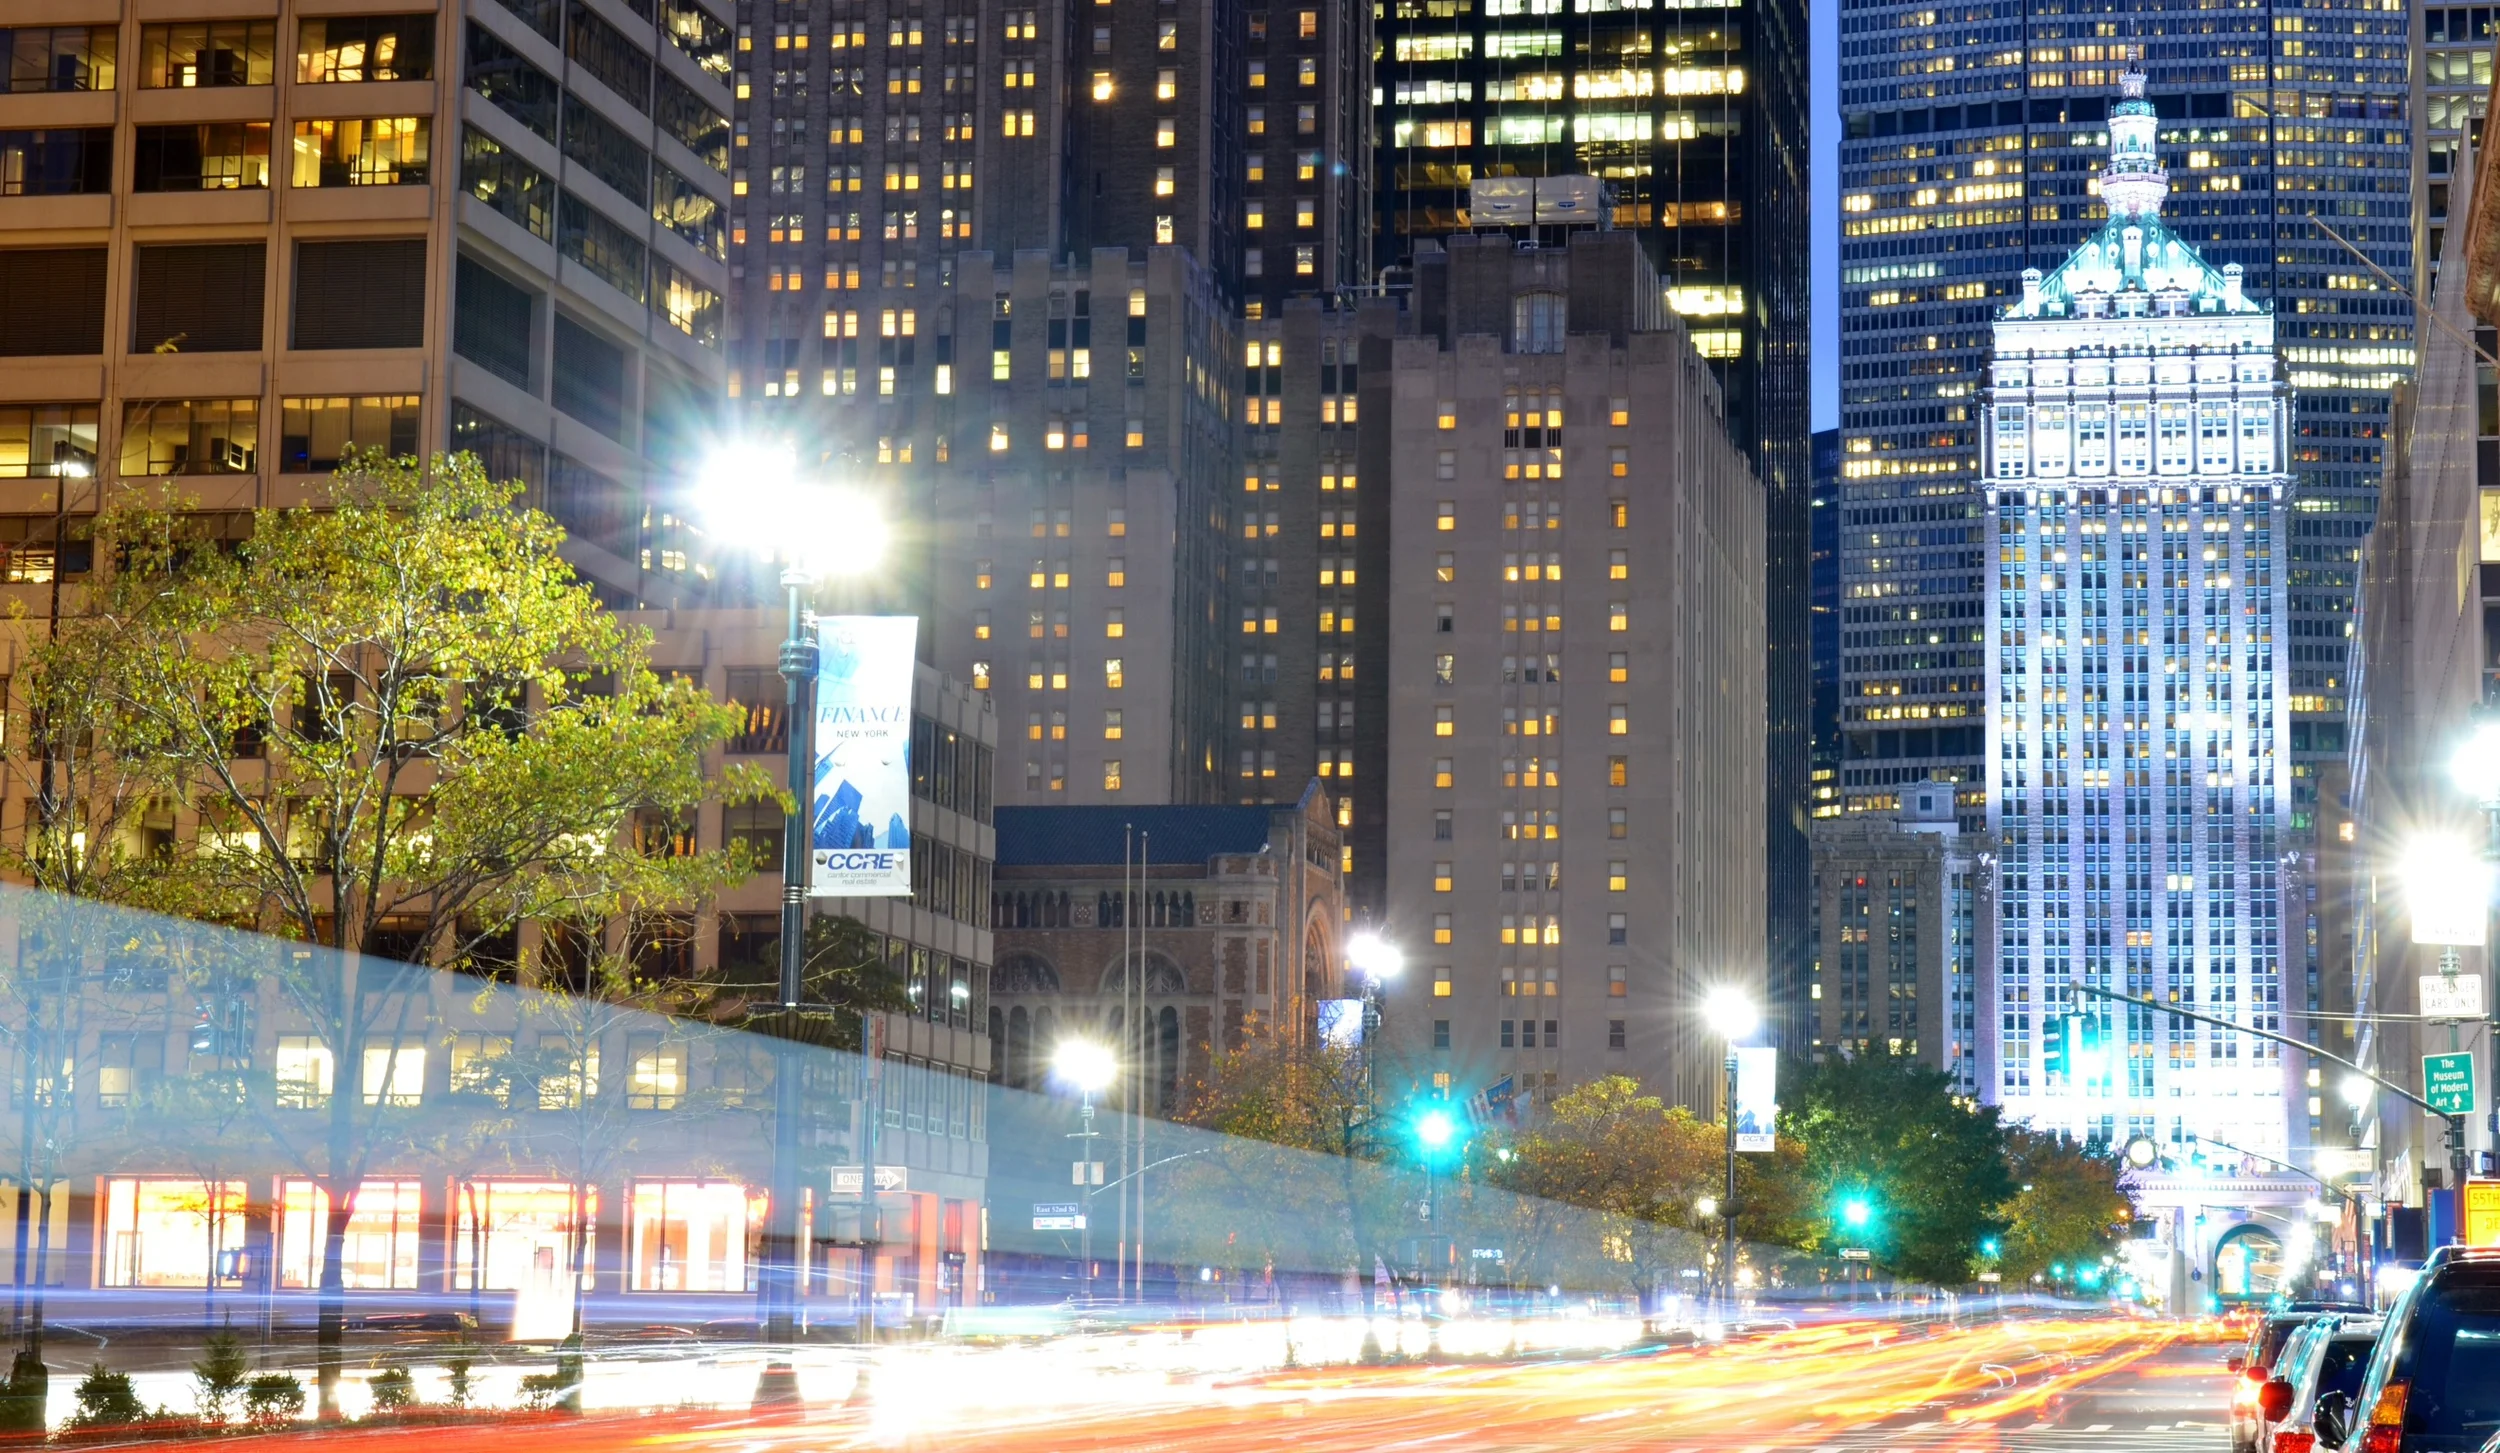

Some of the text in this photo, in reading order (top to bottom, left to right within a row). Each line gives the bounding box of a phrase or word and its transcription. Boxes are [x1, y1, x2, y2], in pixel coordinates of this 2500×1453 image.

[820, 706, 907, 723] FINANCE
[836, 729, 889, 738] NEW YORK
[827, 853, 894, 870] CCRE
[827, 871, 892, 879] cantor commercial
[2424, 981, 2476, 994] PASSENGER
[2425, 997, 2476, 1009] CARS ONLY
[2440, 1059, 2455, 1069] The
[2433, 1071, 2465, 1082] Museum
[2430, 1082, 2469, 1094] of Modern
[2435, 1097, 2448, 1107] Art
[842, 1174, 863, 1184] ONE
